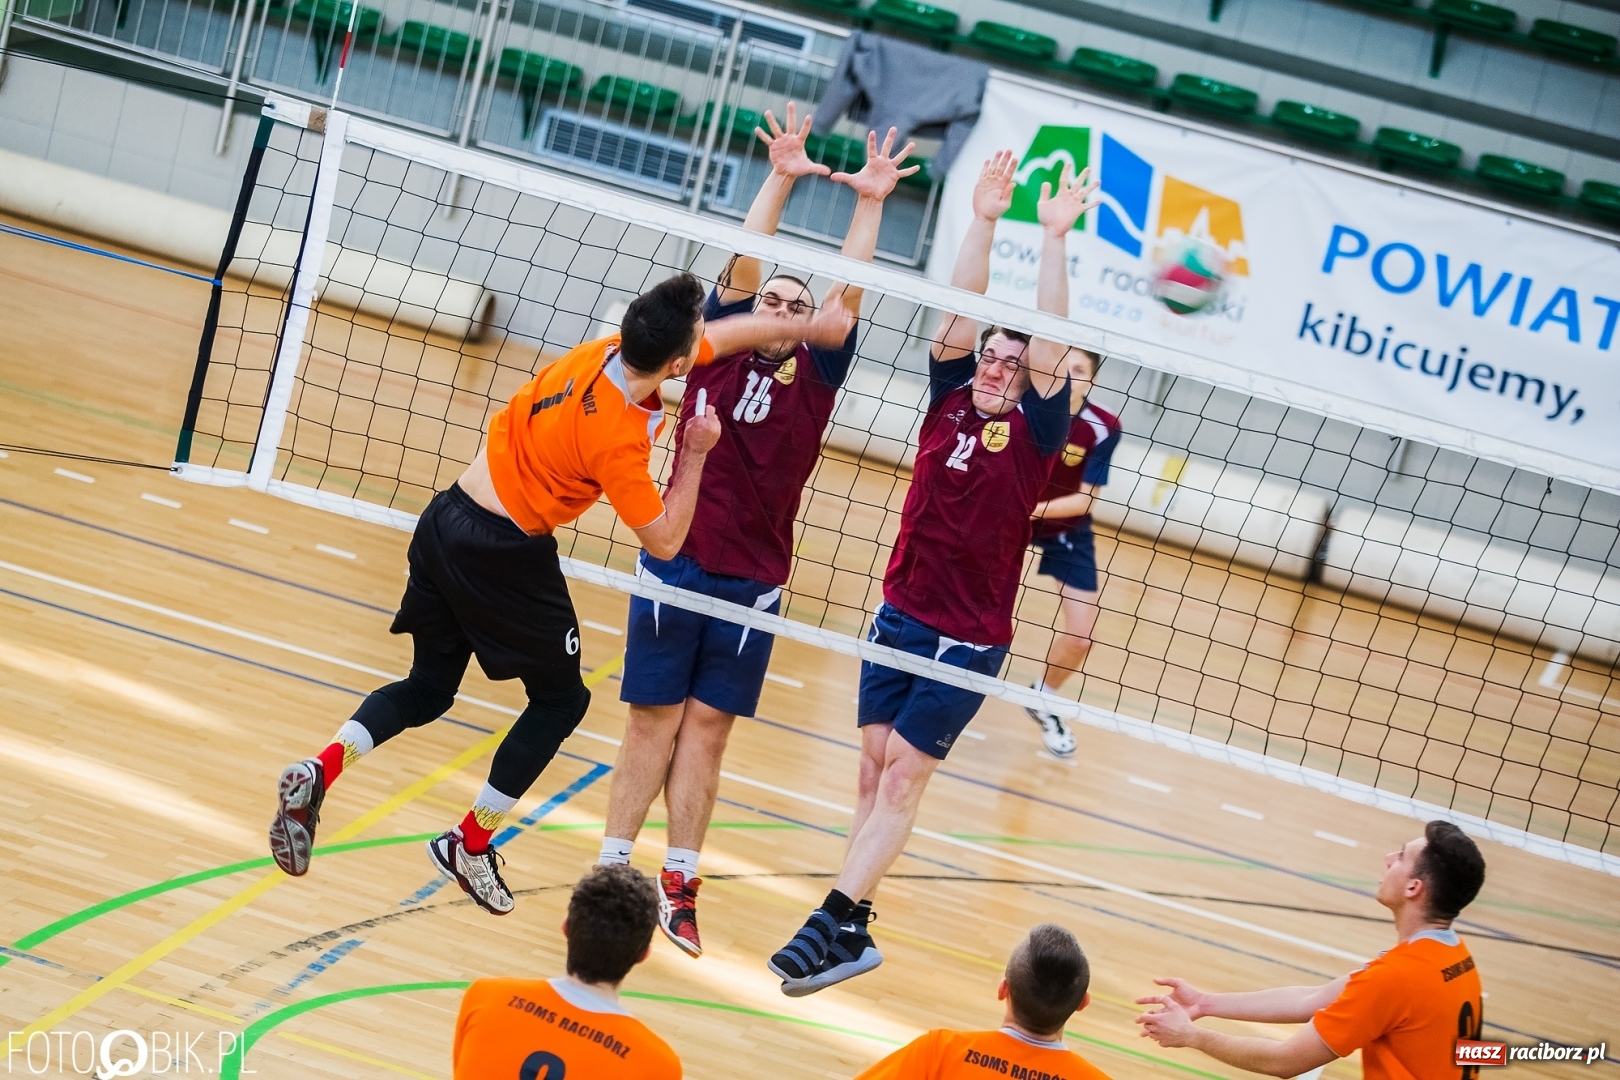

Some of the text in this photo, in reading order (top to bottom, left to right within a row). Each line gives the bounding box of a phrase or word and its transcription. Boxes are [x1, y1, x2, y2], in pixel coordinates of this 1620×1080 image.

[1321, 224, 1620, 351] POWIAT
[1297, 303, 1586, 425] kibicujemy,
[733, 369, 773, 424] 16
[945, 432, 977, 472] 12
[566, 627, 579, 655] 6
[508, 996, 631, 1059] ZSOMS RACIBÓRZ
[964, 1049, 1009, 1075] ZSOMS
